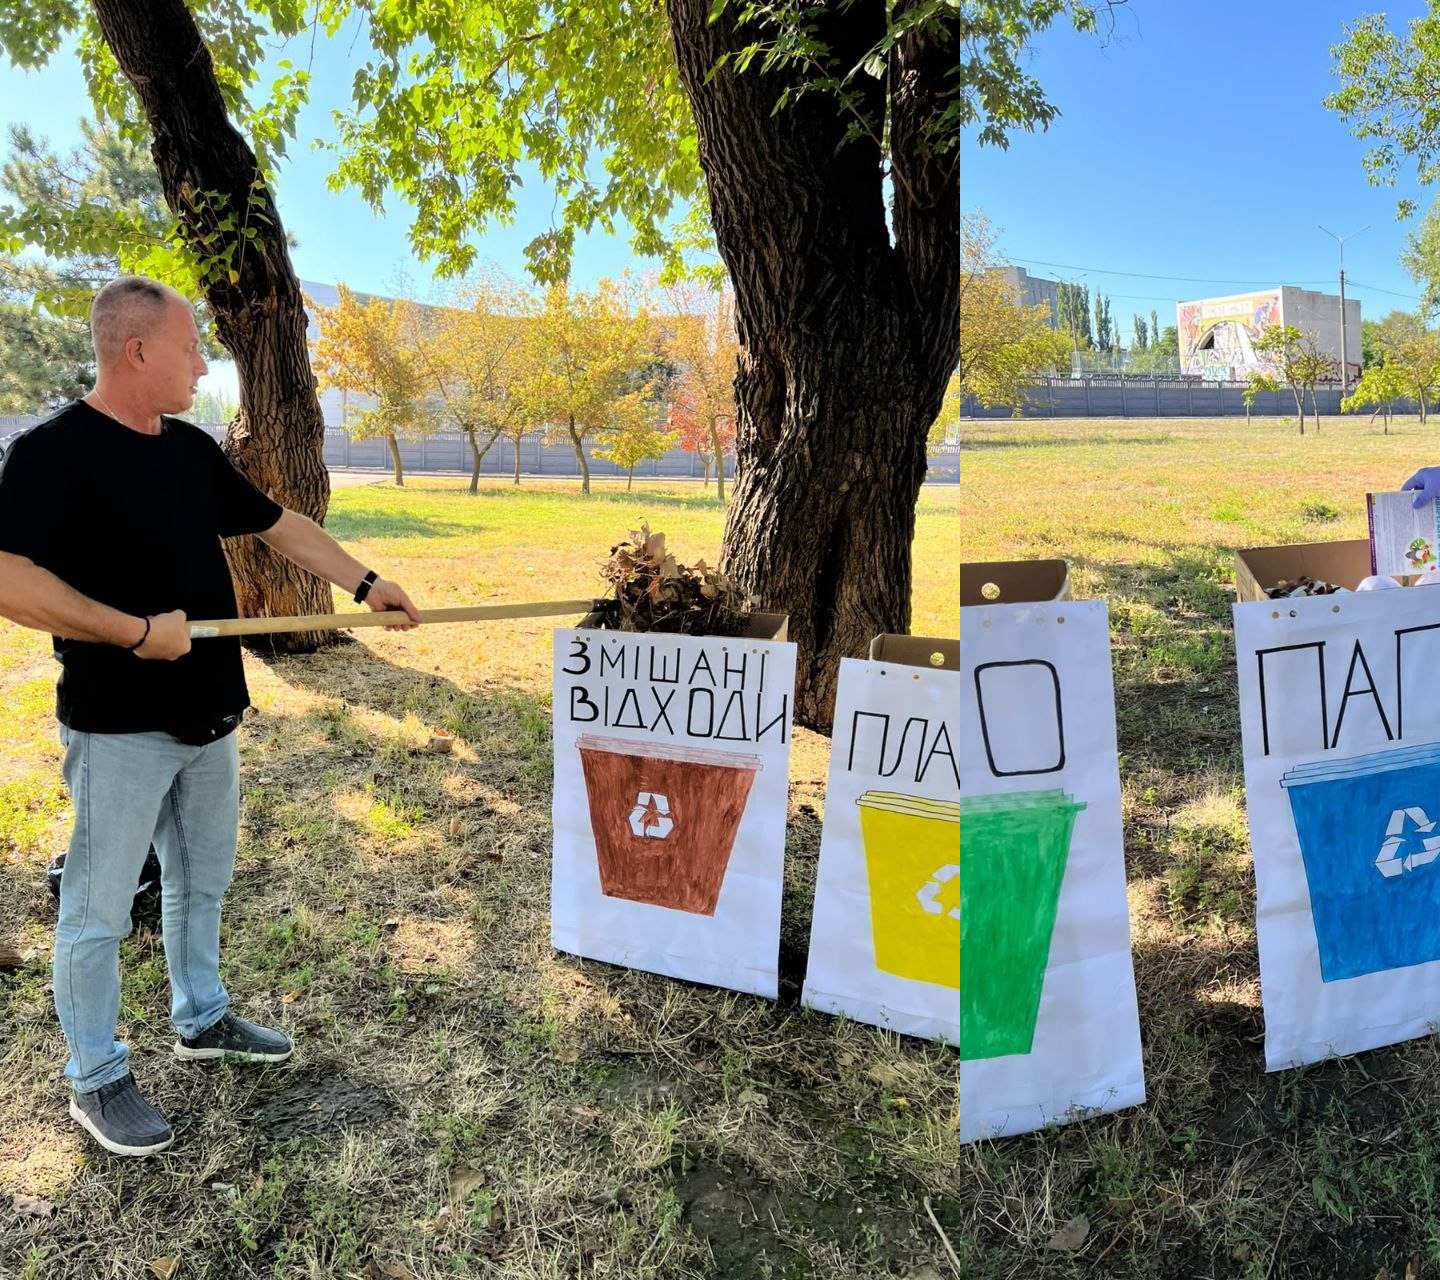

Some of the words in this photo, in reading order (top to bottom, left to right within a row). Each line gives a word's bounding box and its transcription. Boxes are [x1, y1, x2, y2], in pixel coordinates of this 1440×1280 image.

[562, 641, 767, 692] ЗМІШАНІ
[570, 686, 788, 744] ВІДХОДИ
[974, 659, 1066, 777] О
